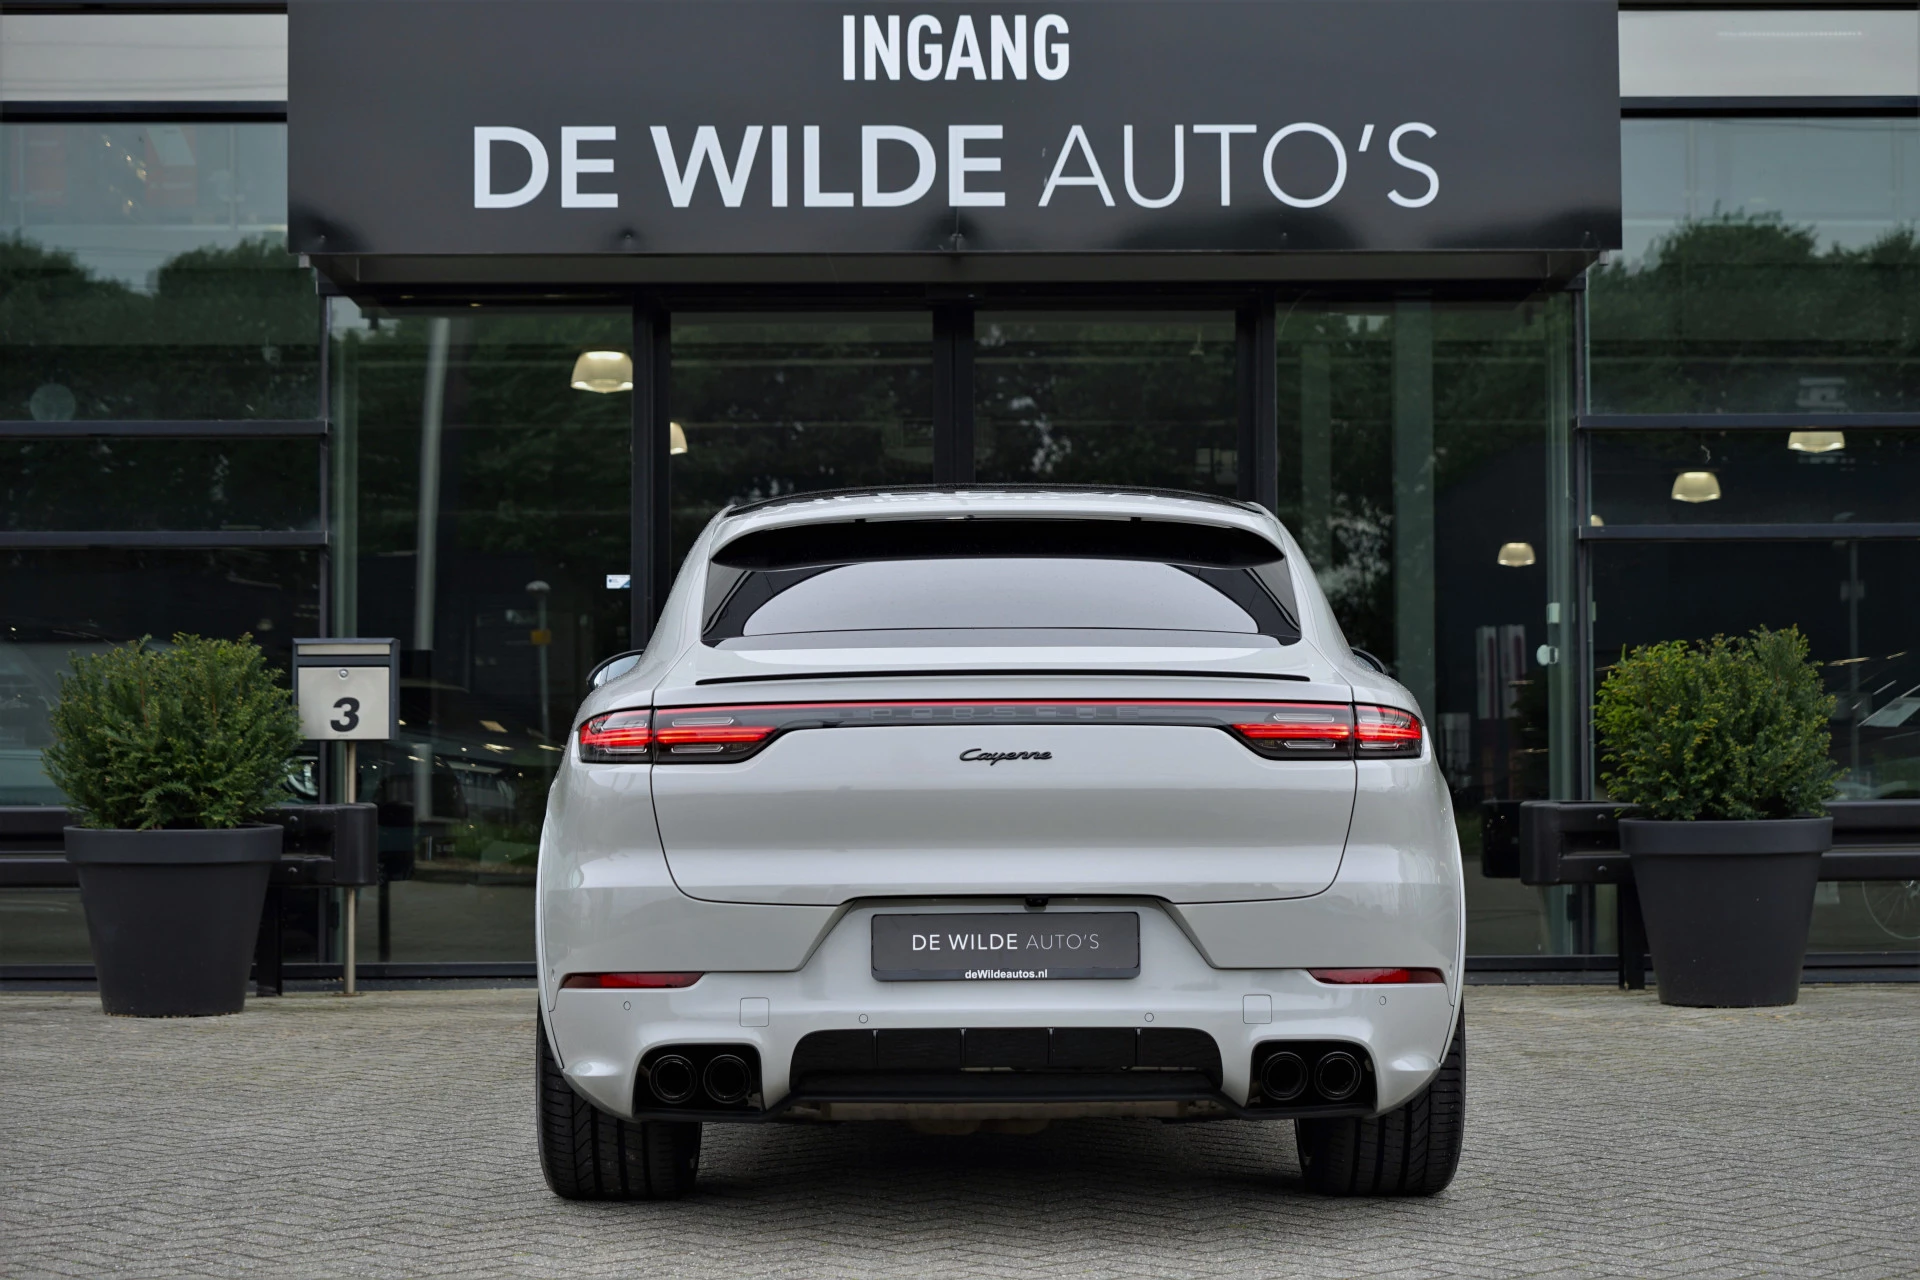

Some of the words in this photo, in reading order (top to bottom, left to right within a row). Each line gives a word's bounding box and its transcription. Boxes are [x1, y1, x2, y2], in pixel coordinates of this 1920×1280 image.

[843, 14, 1070, 82] INGANG
[473, 125, 618, 209] DE
[650, 124, 1006, 209] WILDE
[1038, 121, 1440, 208] AUTO'S
[330, 697, 360, 732] 3
[959, 747, 1053, 767] Cayenne
[912, 933, 941, 951] DE
[948, 933, 1018, 951] WILDE
[1025, 933, 1100, 950] AUTO'S
[964, 968, 1048, 980] deWildeautos.nl
